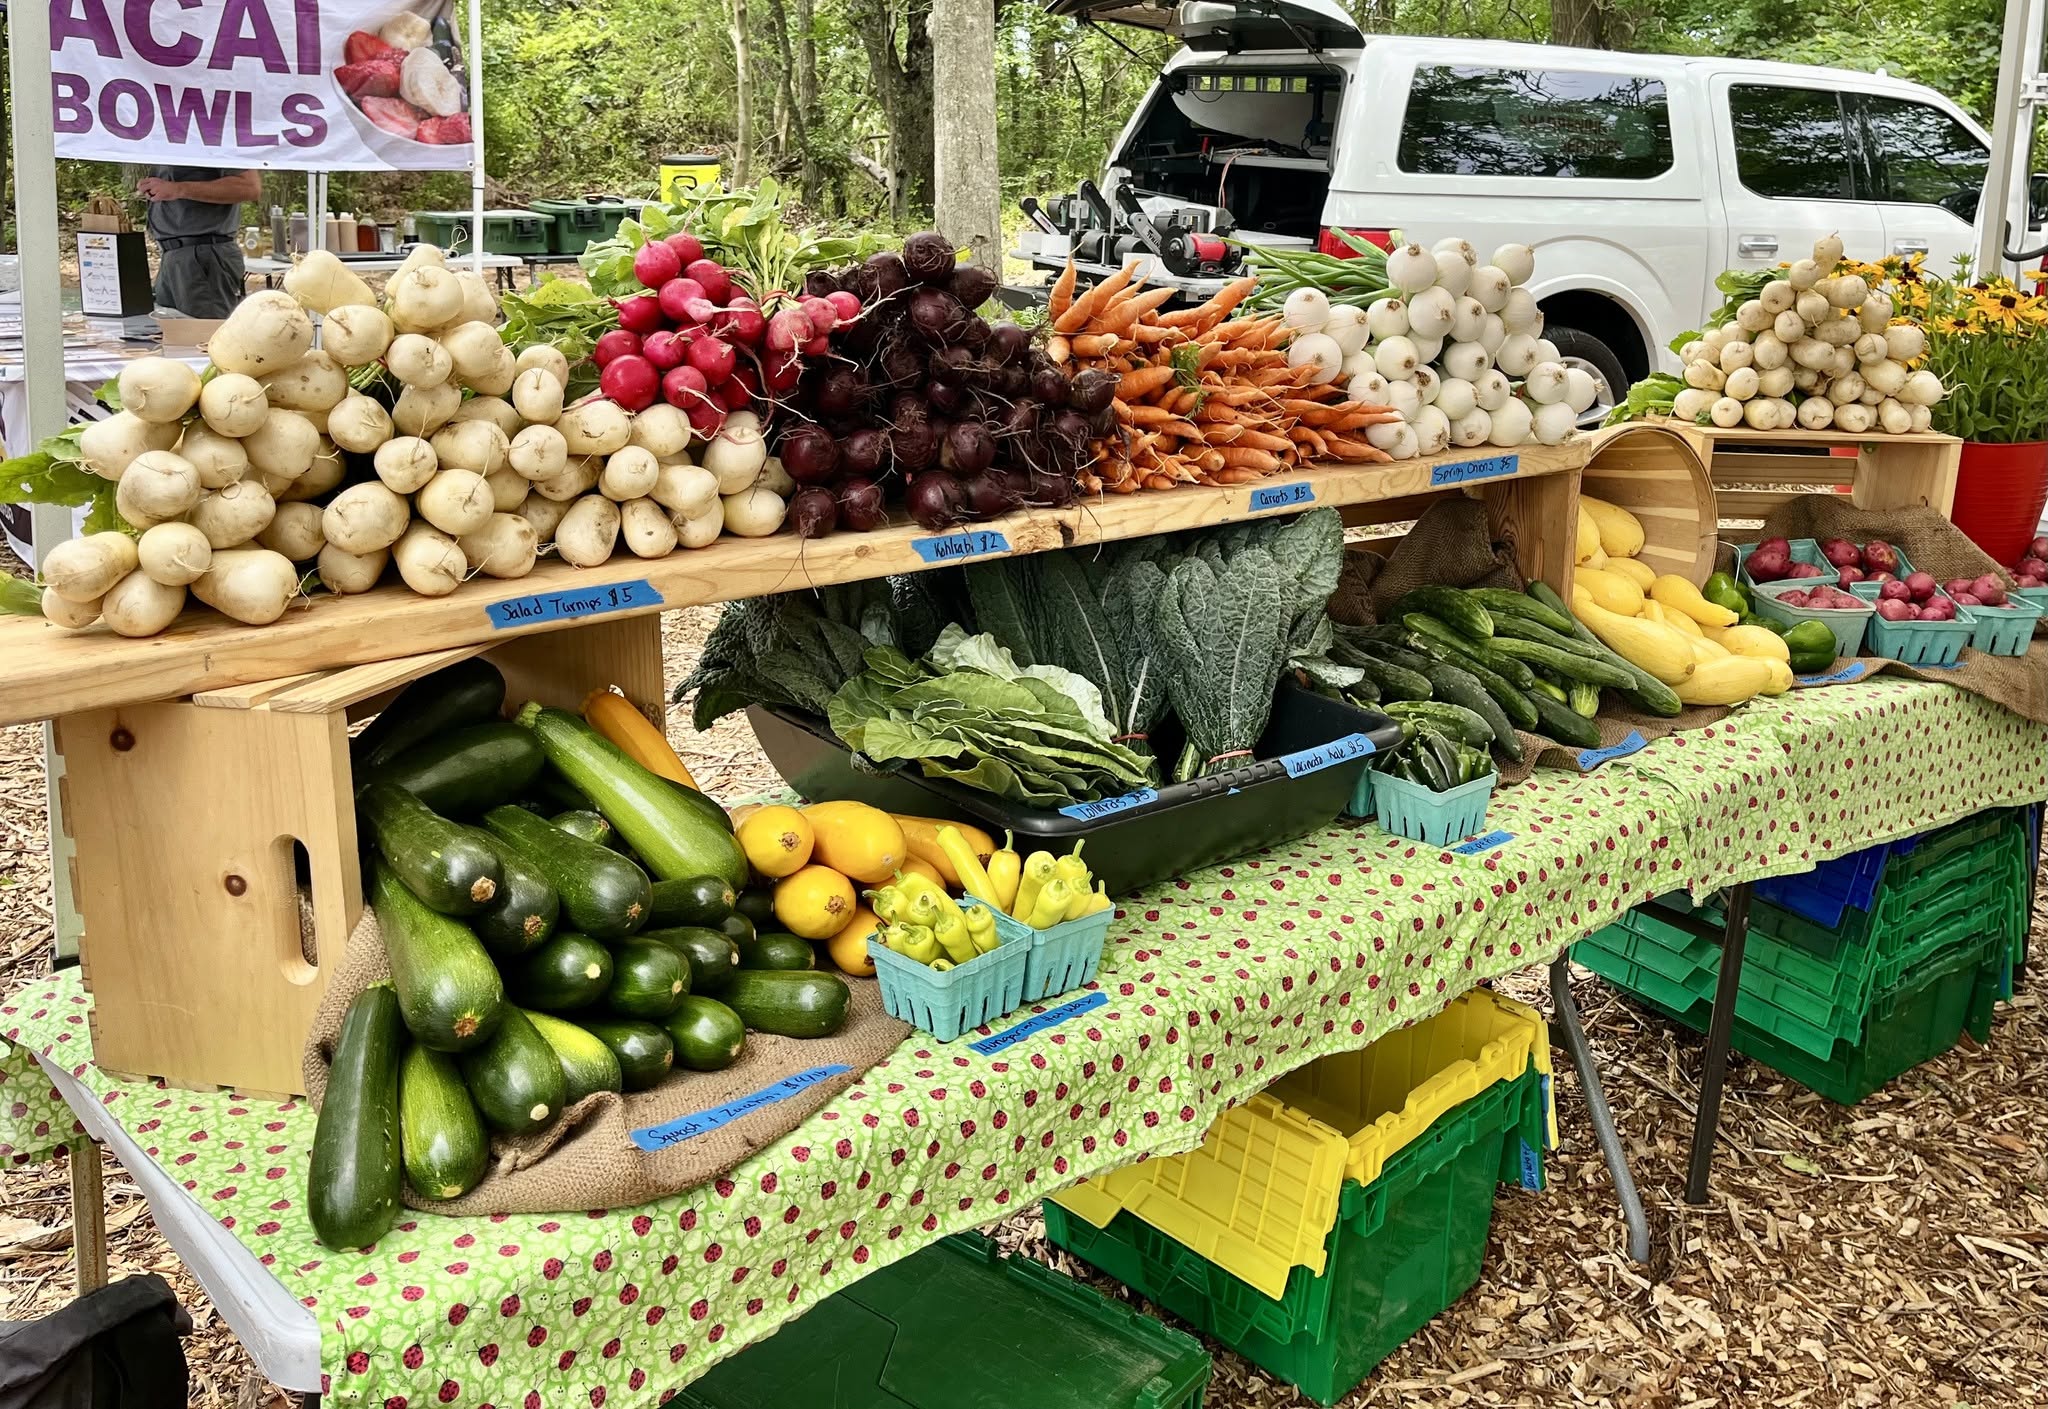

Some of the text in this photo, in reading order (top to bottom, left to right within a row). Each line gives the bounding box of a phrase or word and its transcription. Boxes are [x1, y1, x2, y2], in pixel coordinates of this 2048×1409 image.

[50, 0, 321, 75] ACAI
[51, 72, 328, 147] BOWLS
[1434, 457, 1512, 482] Spring Onions $5
[1260, 486, 1306, 505] Carrots $5
[934, 534, 998, 557] Kohlrabi $2
[502, 585, 633, 621] Salad Turnips $5
[1326, 746, 1346, 760] Kale
[1347, 737, 1365, 755] $5
[977, 1020, 1039, 1052] Hungarian
[648, 1122, 702, 1144] Squash
